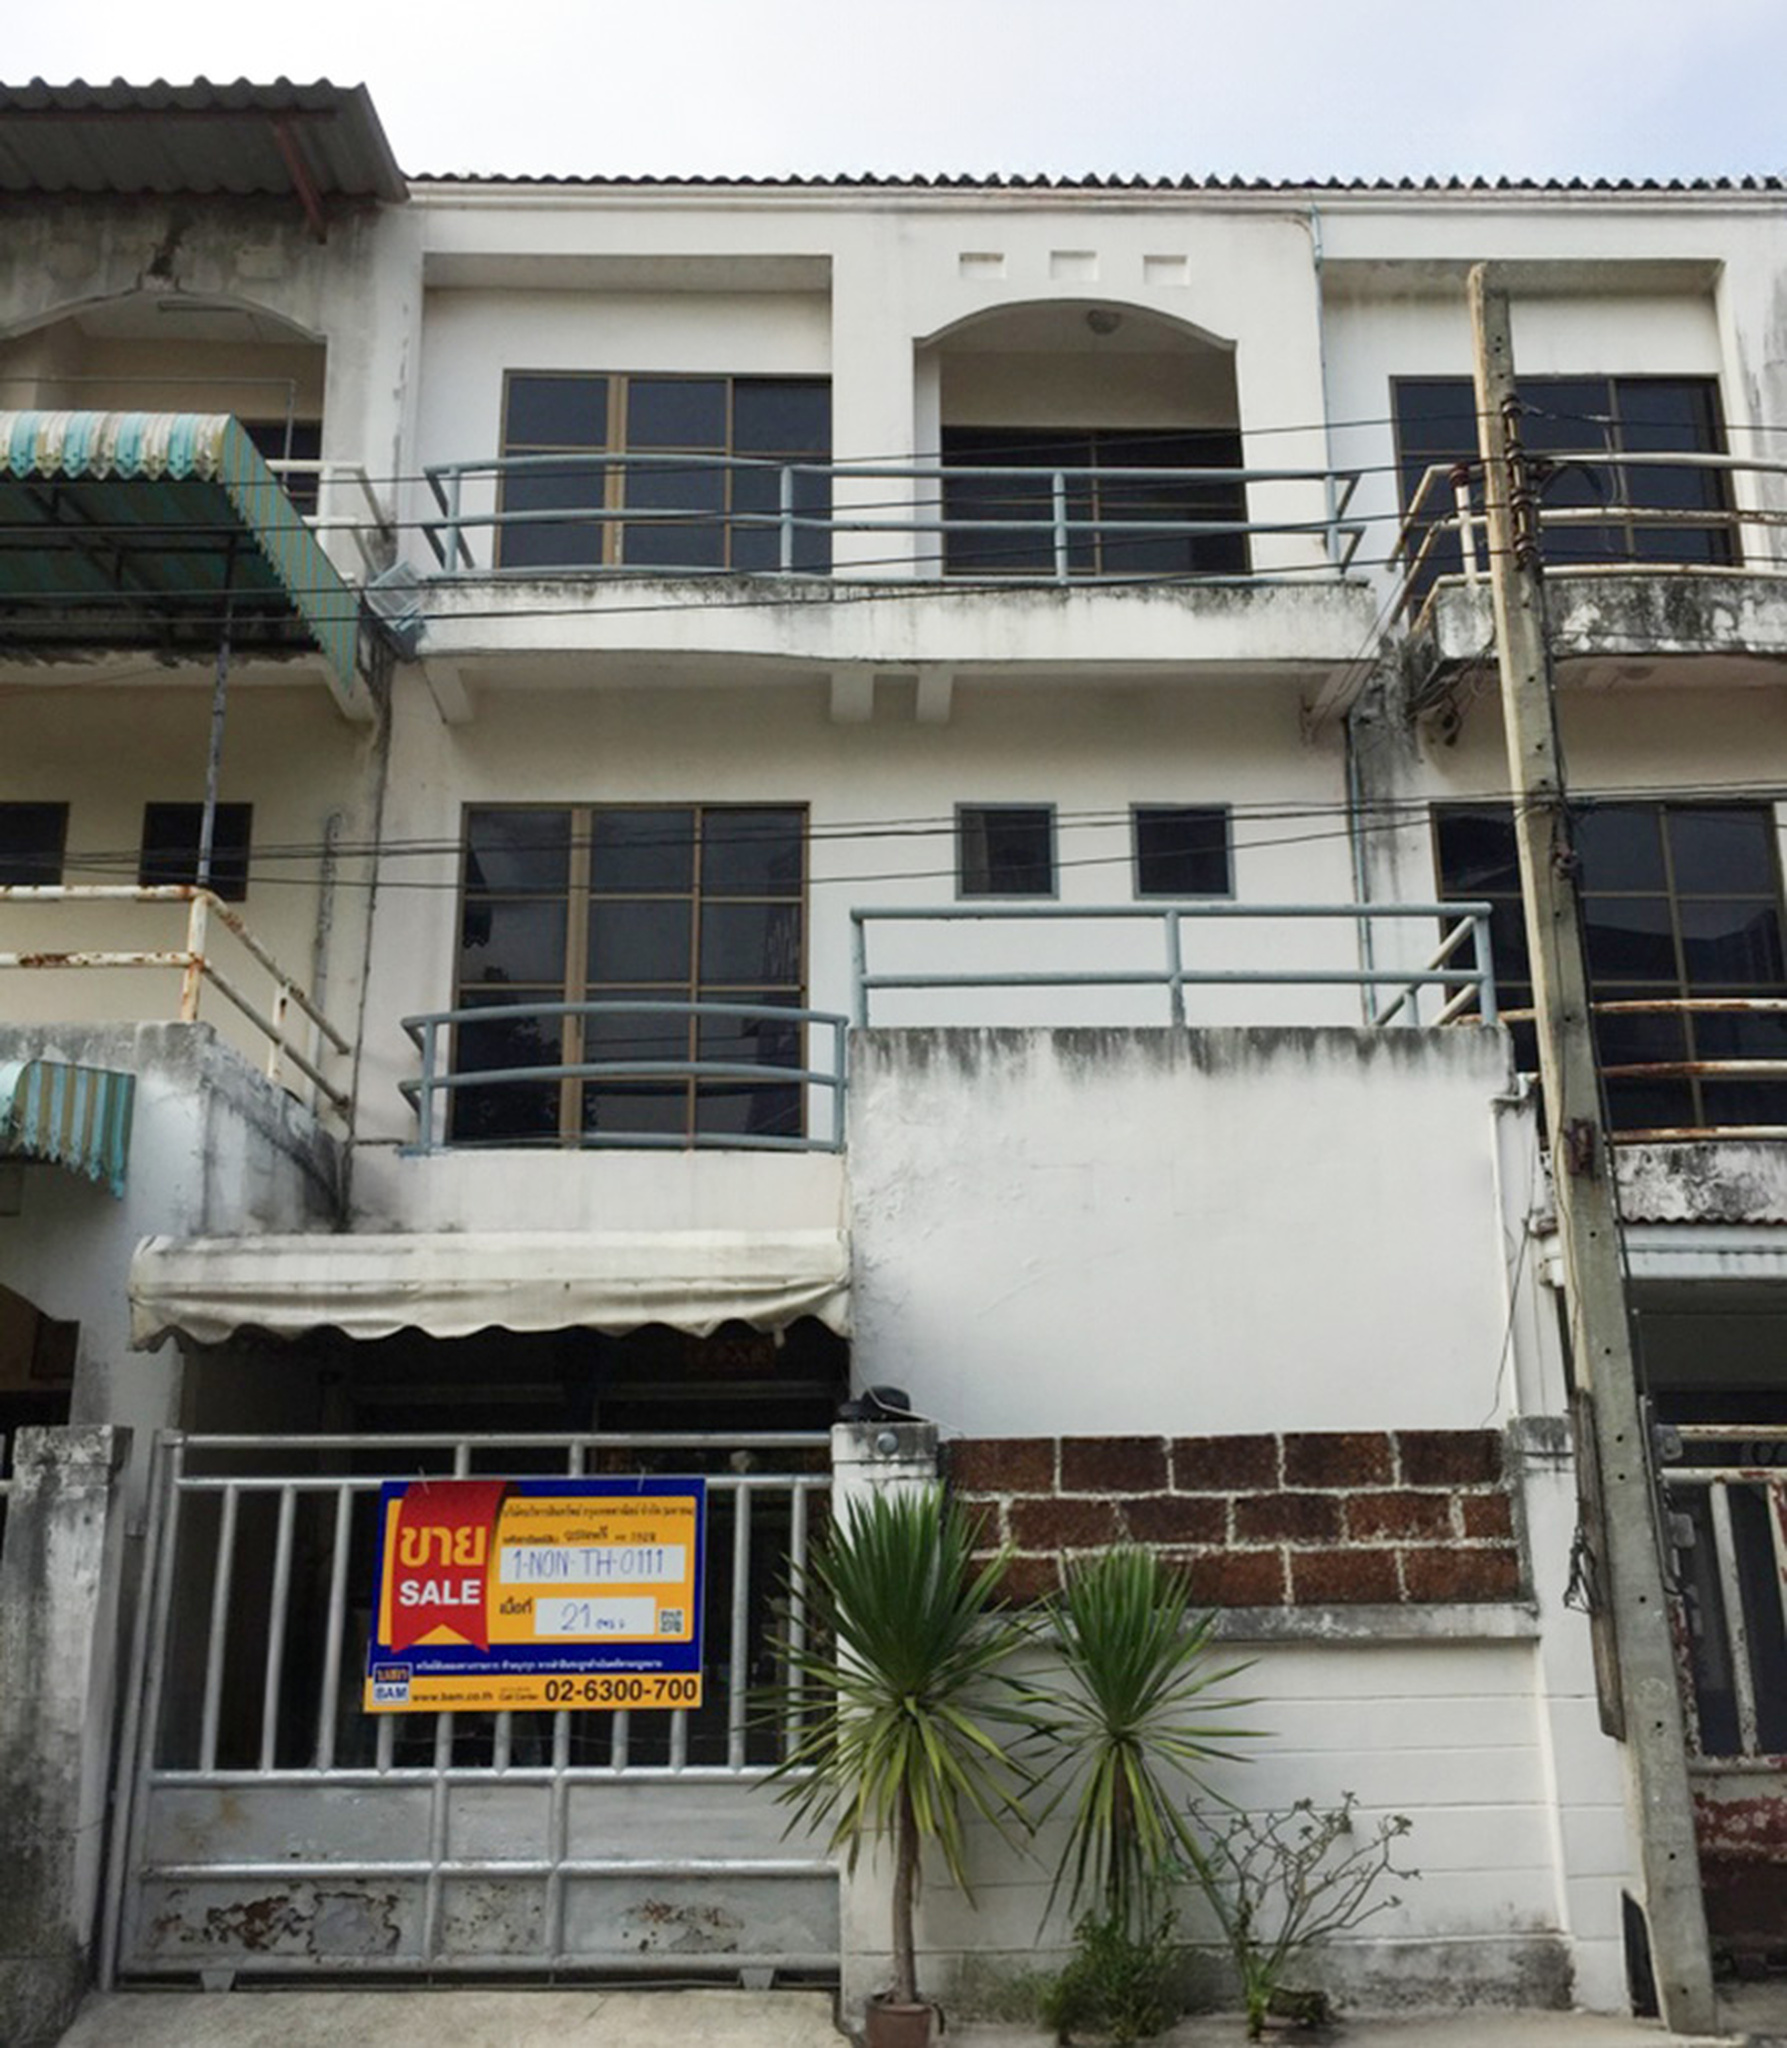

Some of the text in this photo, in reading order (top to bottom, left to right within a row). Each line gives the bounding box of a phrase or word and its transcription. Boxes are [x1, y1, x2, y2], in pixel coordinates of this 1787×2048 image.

[401, 1526, 486, 1567] ขาย
[400, 1580, 481, 1605] SALE
[561, 1602, 591, 1631] 21
[545, 1679, 697, 1702] 02-6300-700
